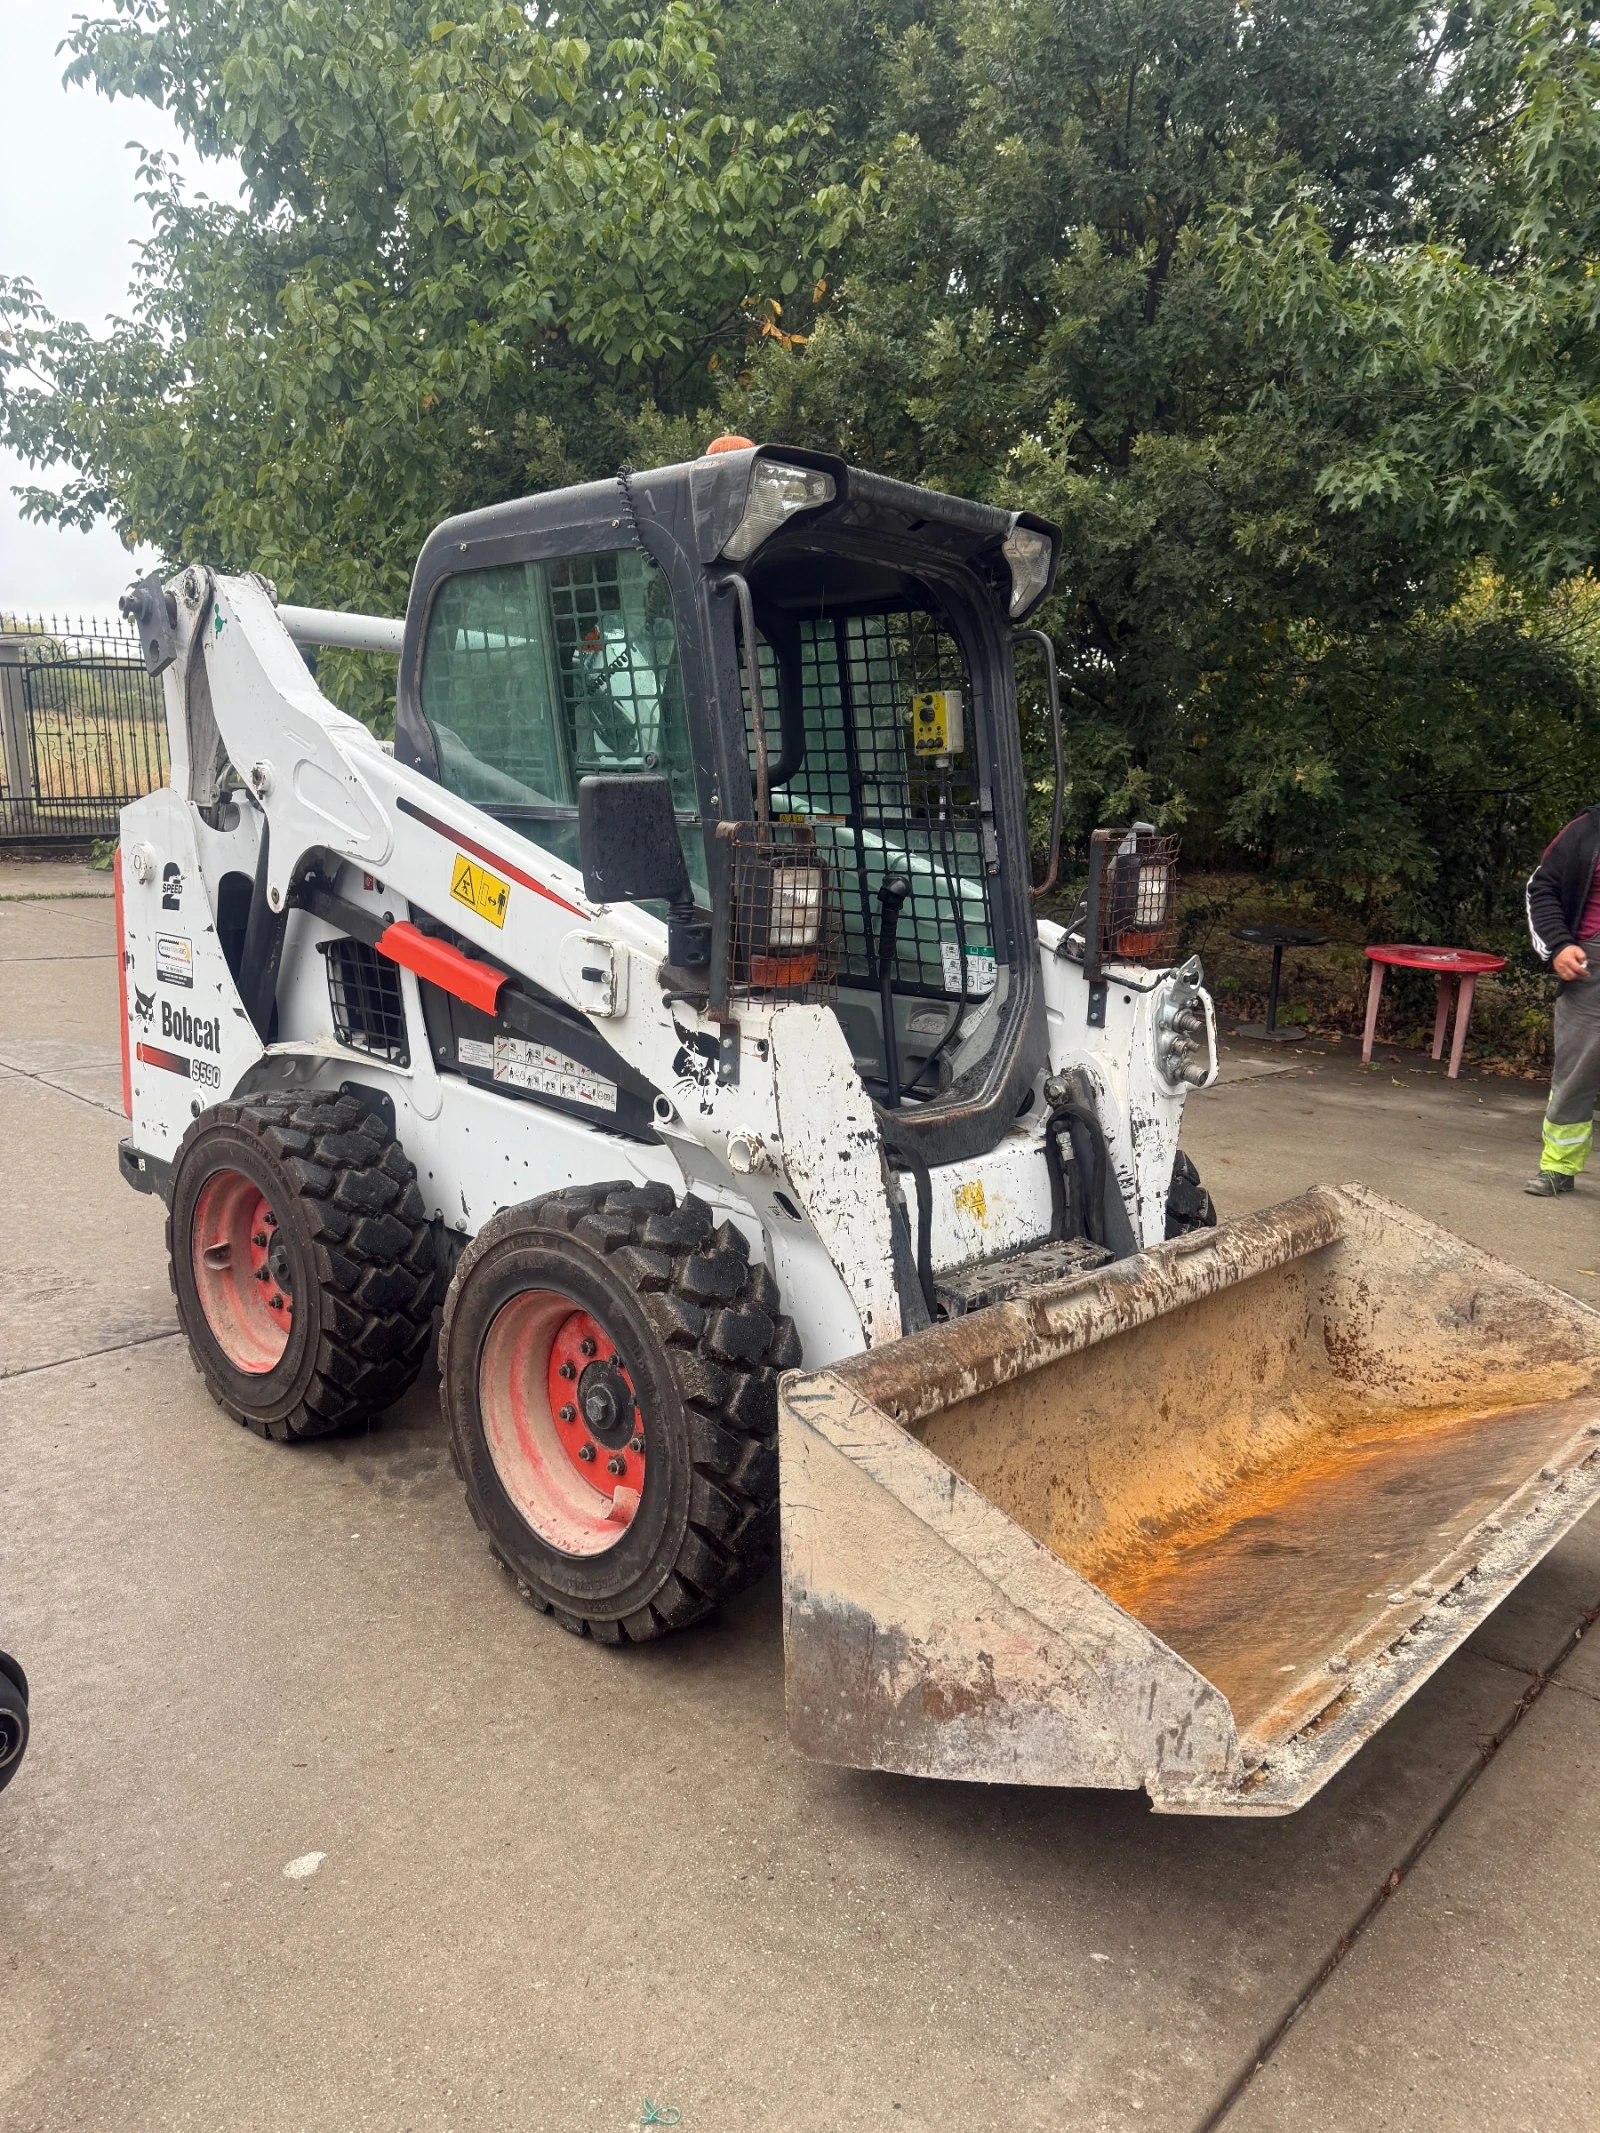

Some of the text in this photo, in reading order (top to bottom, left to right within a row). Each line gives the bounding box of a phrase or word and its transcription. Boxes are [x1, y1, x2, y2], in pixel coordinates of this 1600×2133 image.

[162, 883, 183, 895] SPEED
[161, 1000, 221, 1054] Bobcat
[191, 1058, 221, 1089] S590
